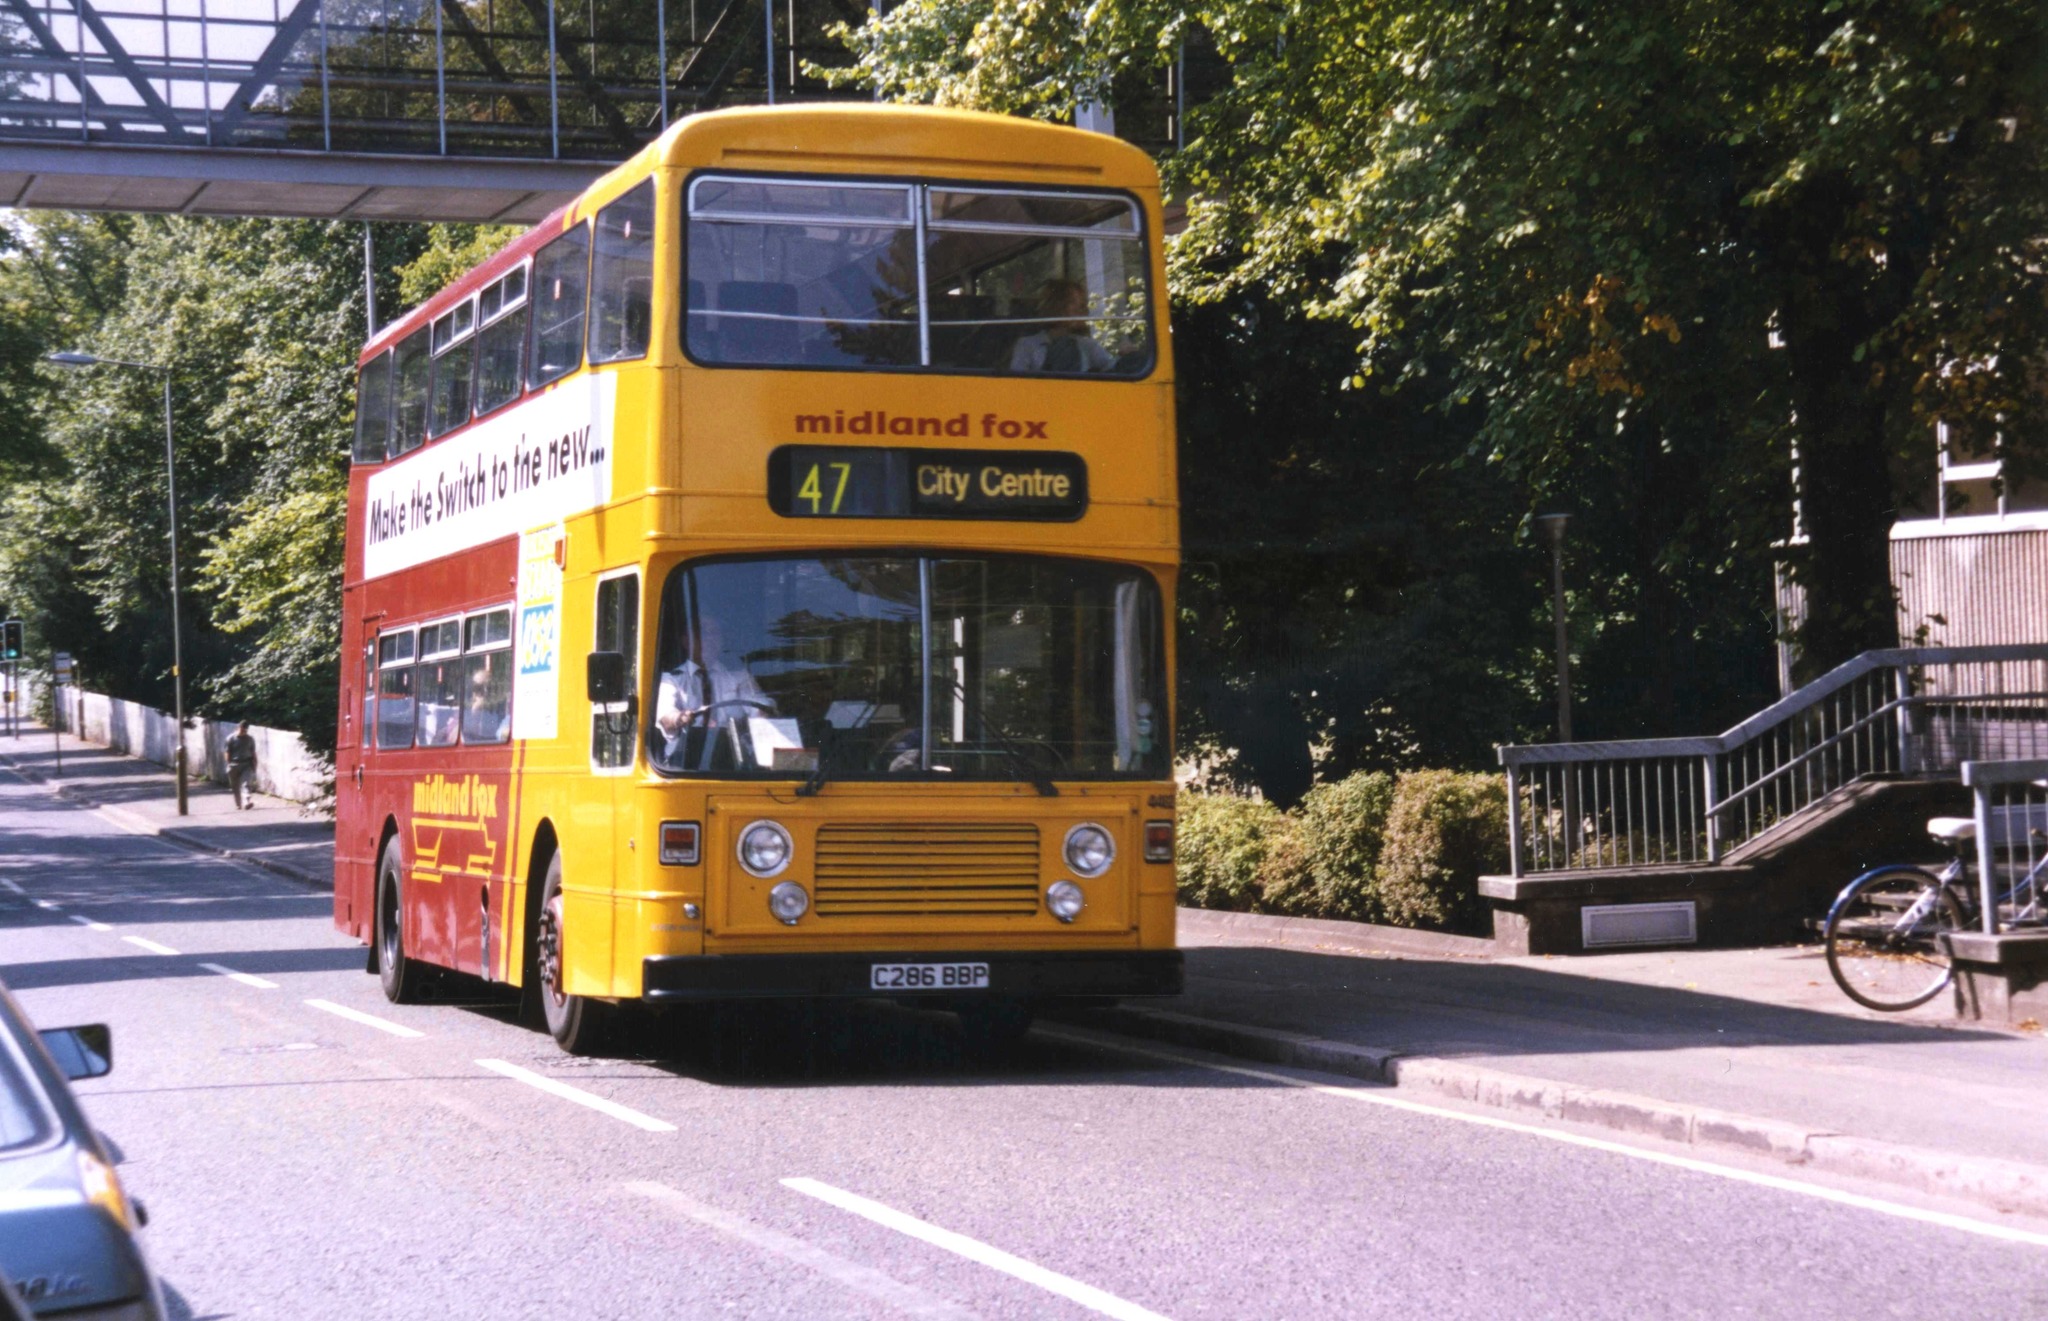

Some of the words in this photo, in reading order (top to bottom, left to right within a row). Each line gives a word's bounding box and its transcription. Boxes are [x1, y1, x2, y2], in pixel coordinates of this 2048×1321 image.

[795, 410, 969, 437] midland
[982, 413, 1049, 439] fox
[368, 490, 406, 546] Make
[411, 479, 432, 532] the
[436, 452, 486, 522] Switch
[492, 453, 508, 502] to
[513, 432, 542, 493] the
[798, 462, 851, 514] 47
[917, 465, 970, 501] City
[980, 467, 1071, 497] Centre
[413, 774, 470, 816] midland
[472, 774, 498, 818] fox
[874, 967, 935, 986] C286
[942, 966, 987, 985] BBP
